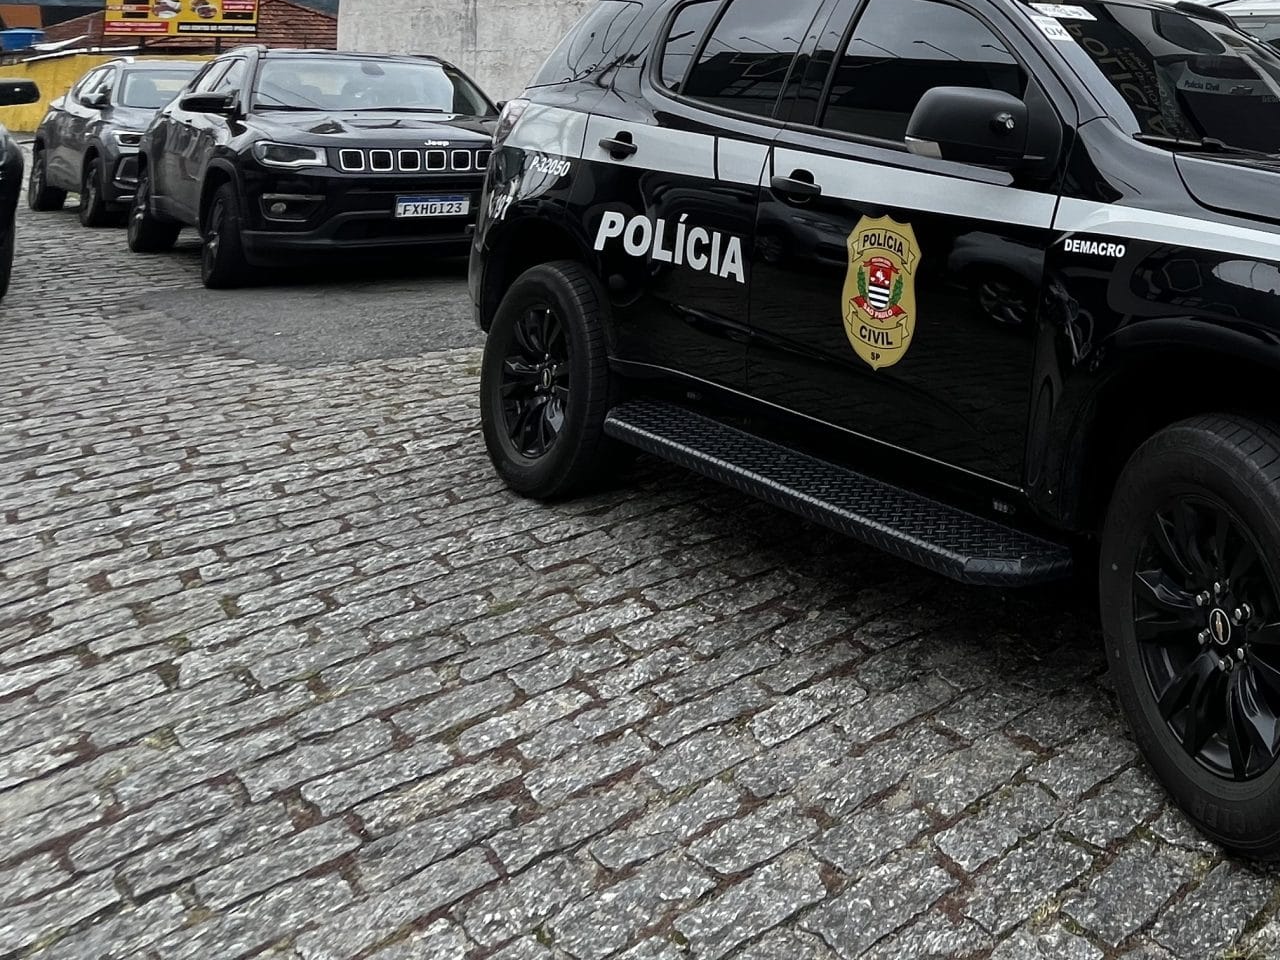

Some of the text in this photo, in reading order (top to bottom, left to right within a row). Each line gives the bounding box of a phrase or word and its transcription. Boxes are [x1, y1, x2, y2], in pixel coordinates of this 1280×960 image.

[529, 156, 571, 177] P-32050
[593, 212, 746, 284] POLÍCIA
[862, 229, 904, 257] POLÍCIA
[1063, 239, 1127, 259] DEMACRO
[859, 325, 893, 346] CIVIL
[870, 351, 881, 361] SP
